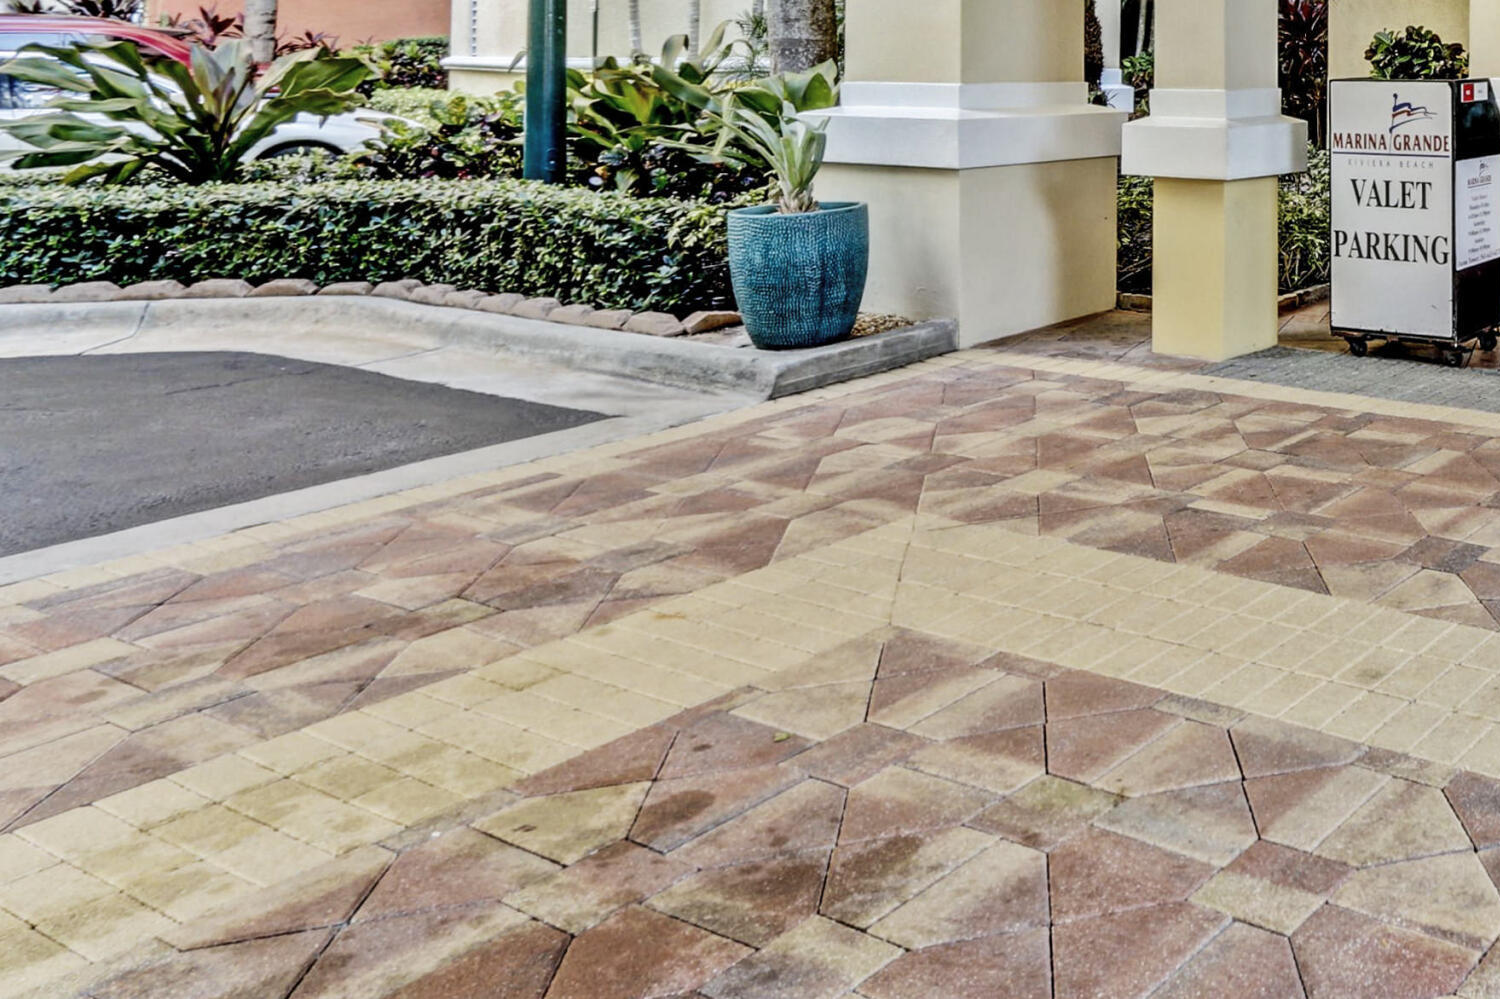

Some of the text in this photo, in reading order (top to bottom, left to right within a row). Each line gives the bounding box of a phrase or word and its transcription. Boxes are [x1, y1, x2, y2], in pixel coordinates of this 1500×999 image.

[1333, 132, 1450, 152] MARINA GRANDE
[1399, 160, 1434, 169] BEACH
[1350, 178, 1432, 210] VALET
[1333, 230, 1450, 265] PARKING
